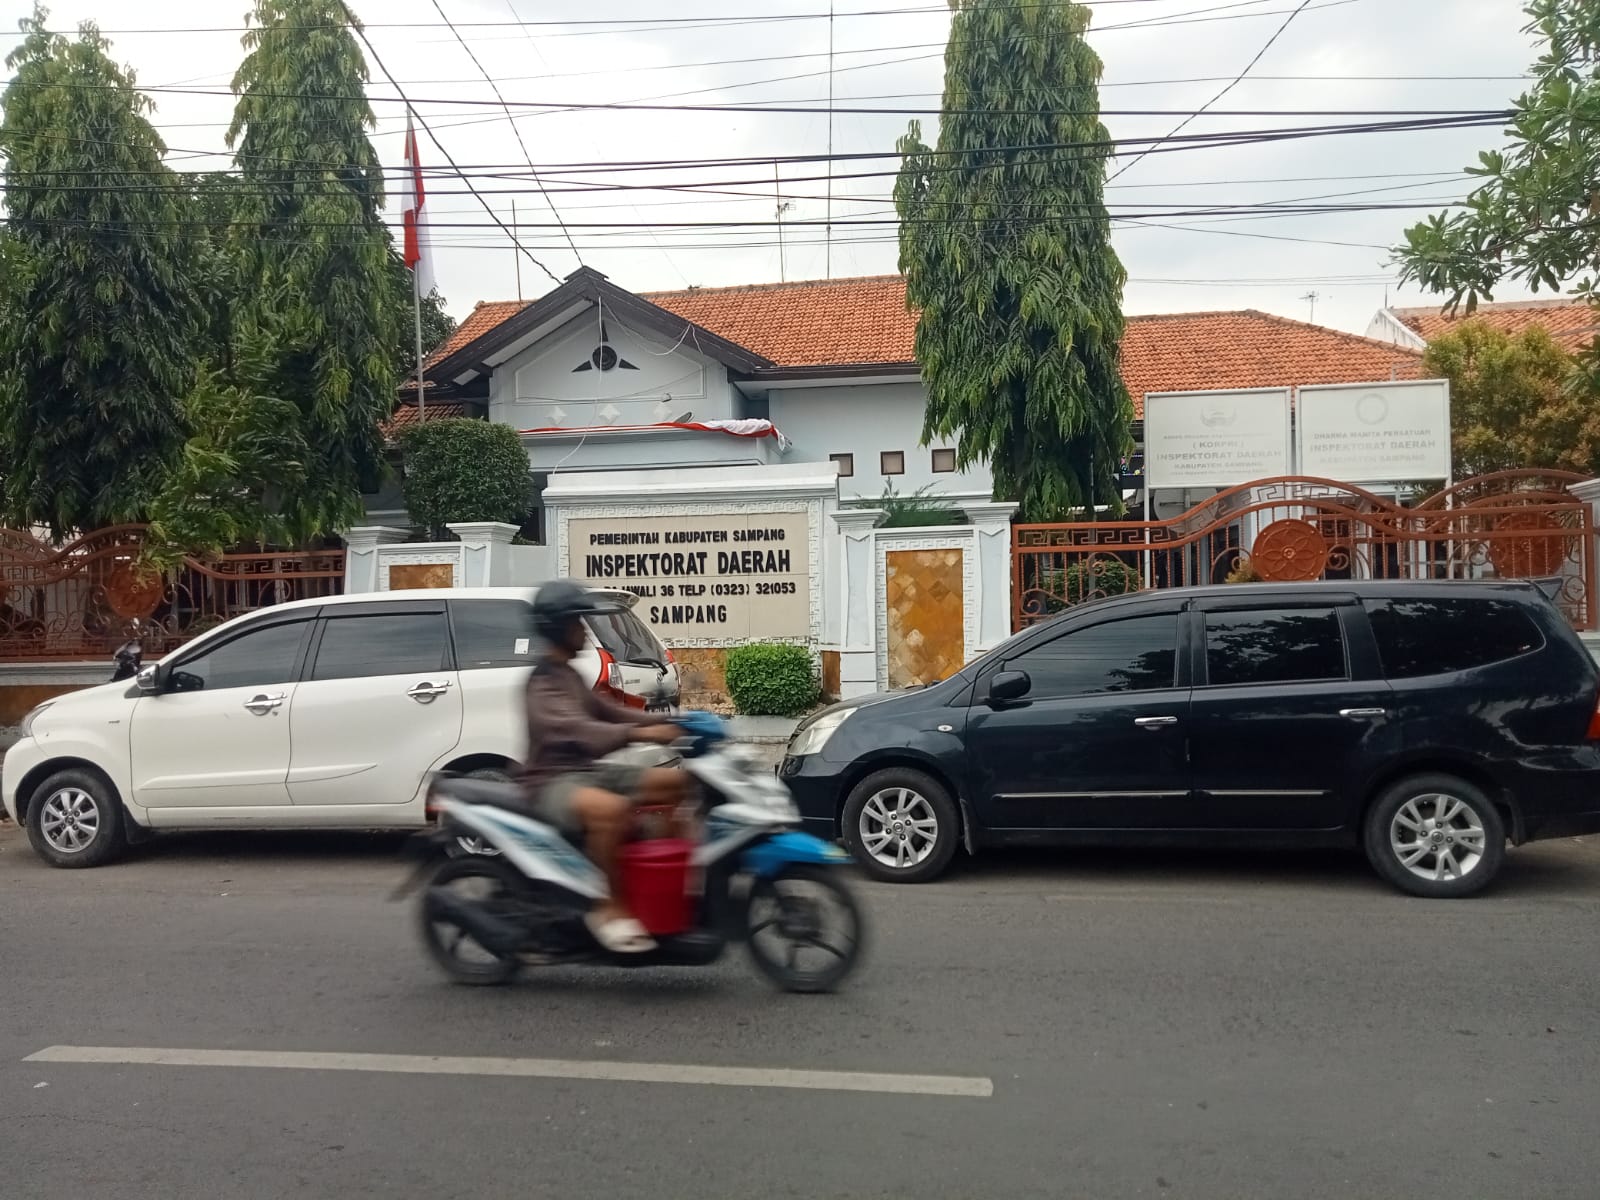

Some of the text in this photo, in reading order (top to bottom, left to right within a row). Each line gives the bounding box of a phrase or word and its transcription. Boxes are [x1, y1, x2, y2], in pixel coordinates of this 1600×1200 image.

[1390, 440, 1436, 449] DAERAH
[1156, 452, 1232, 461] INSPEKTORAT
[590, 529, 785, 545] PEMERINTAH KABUPATEN SAMPANG
[586, 550, 791, 577] INSPEKTORAT DAERAH
[660, 585, 675, 597] 36
[679, 584, 706, 596] TELP
[711, 584, 750, 596] (0323)
[756, 582, 796, 594] 321053
[650, 605, 727, 624] SAMPANG
